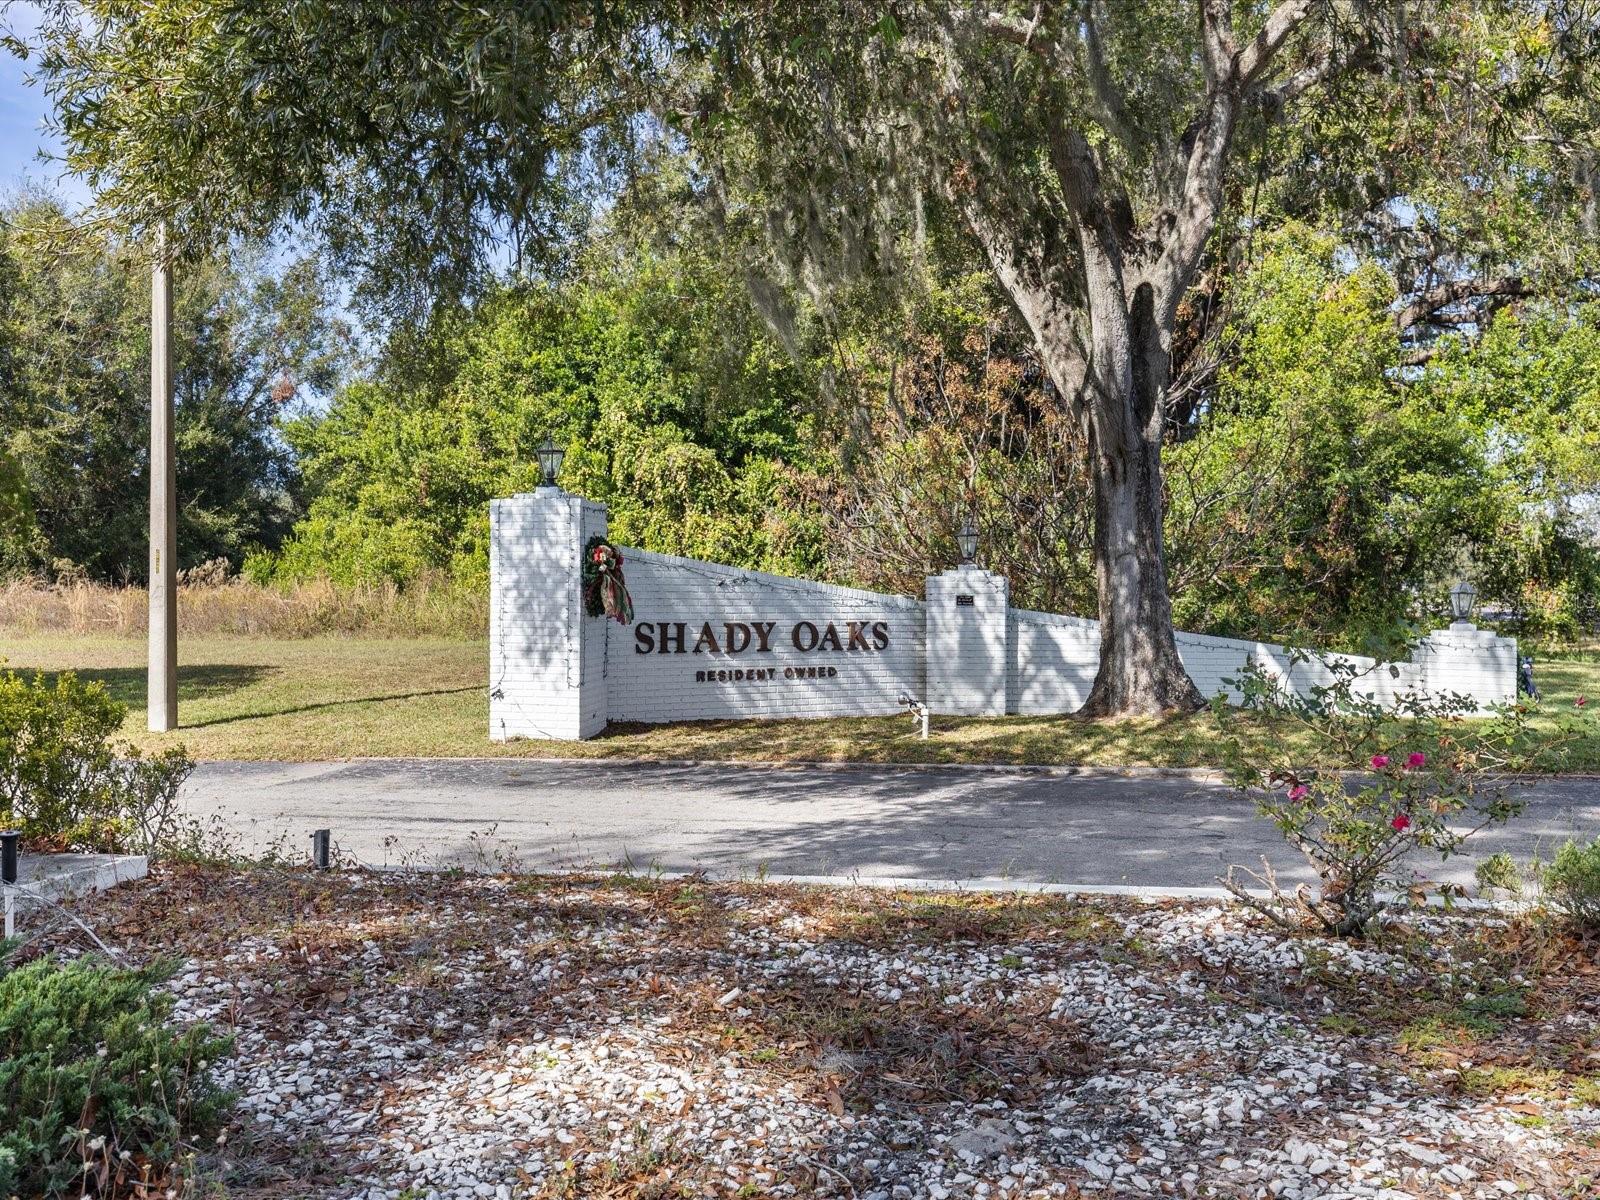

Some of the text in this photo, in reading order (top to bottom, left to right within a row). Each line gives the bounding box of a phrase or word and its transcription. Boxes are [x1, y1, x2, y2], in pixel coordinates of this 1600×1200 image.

[634, 621, 890, 654] SHADY OAKS
[696, 666, 837, 682] RESIDENT OWNED
